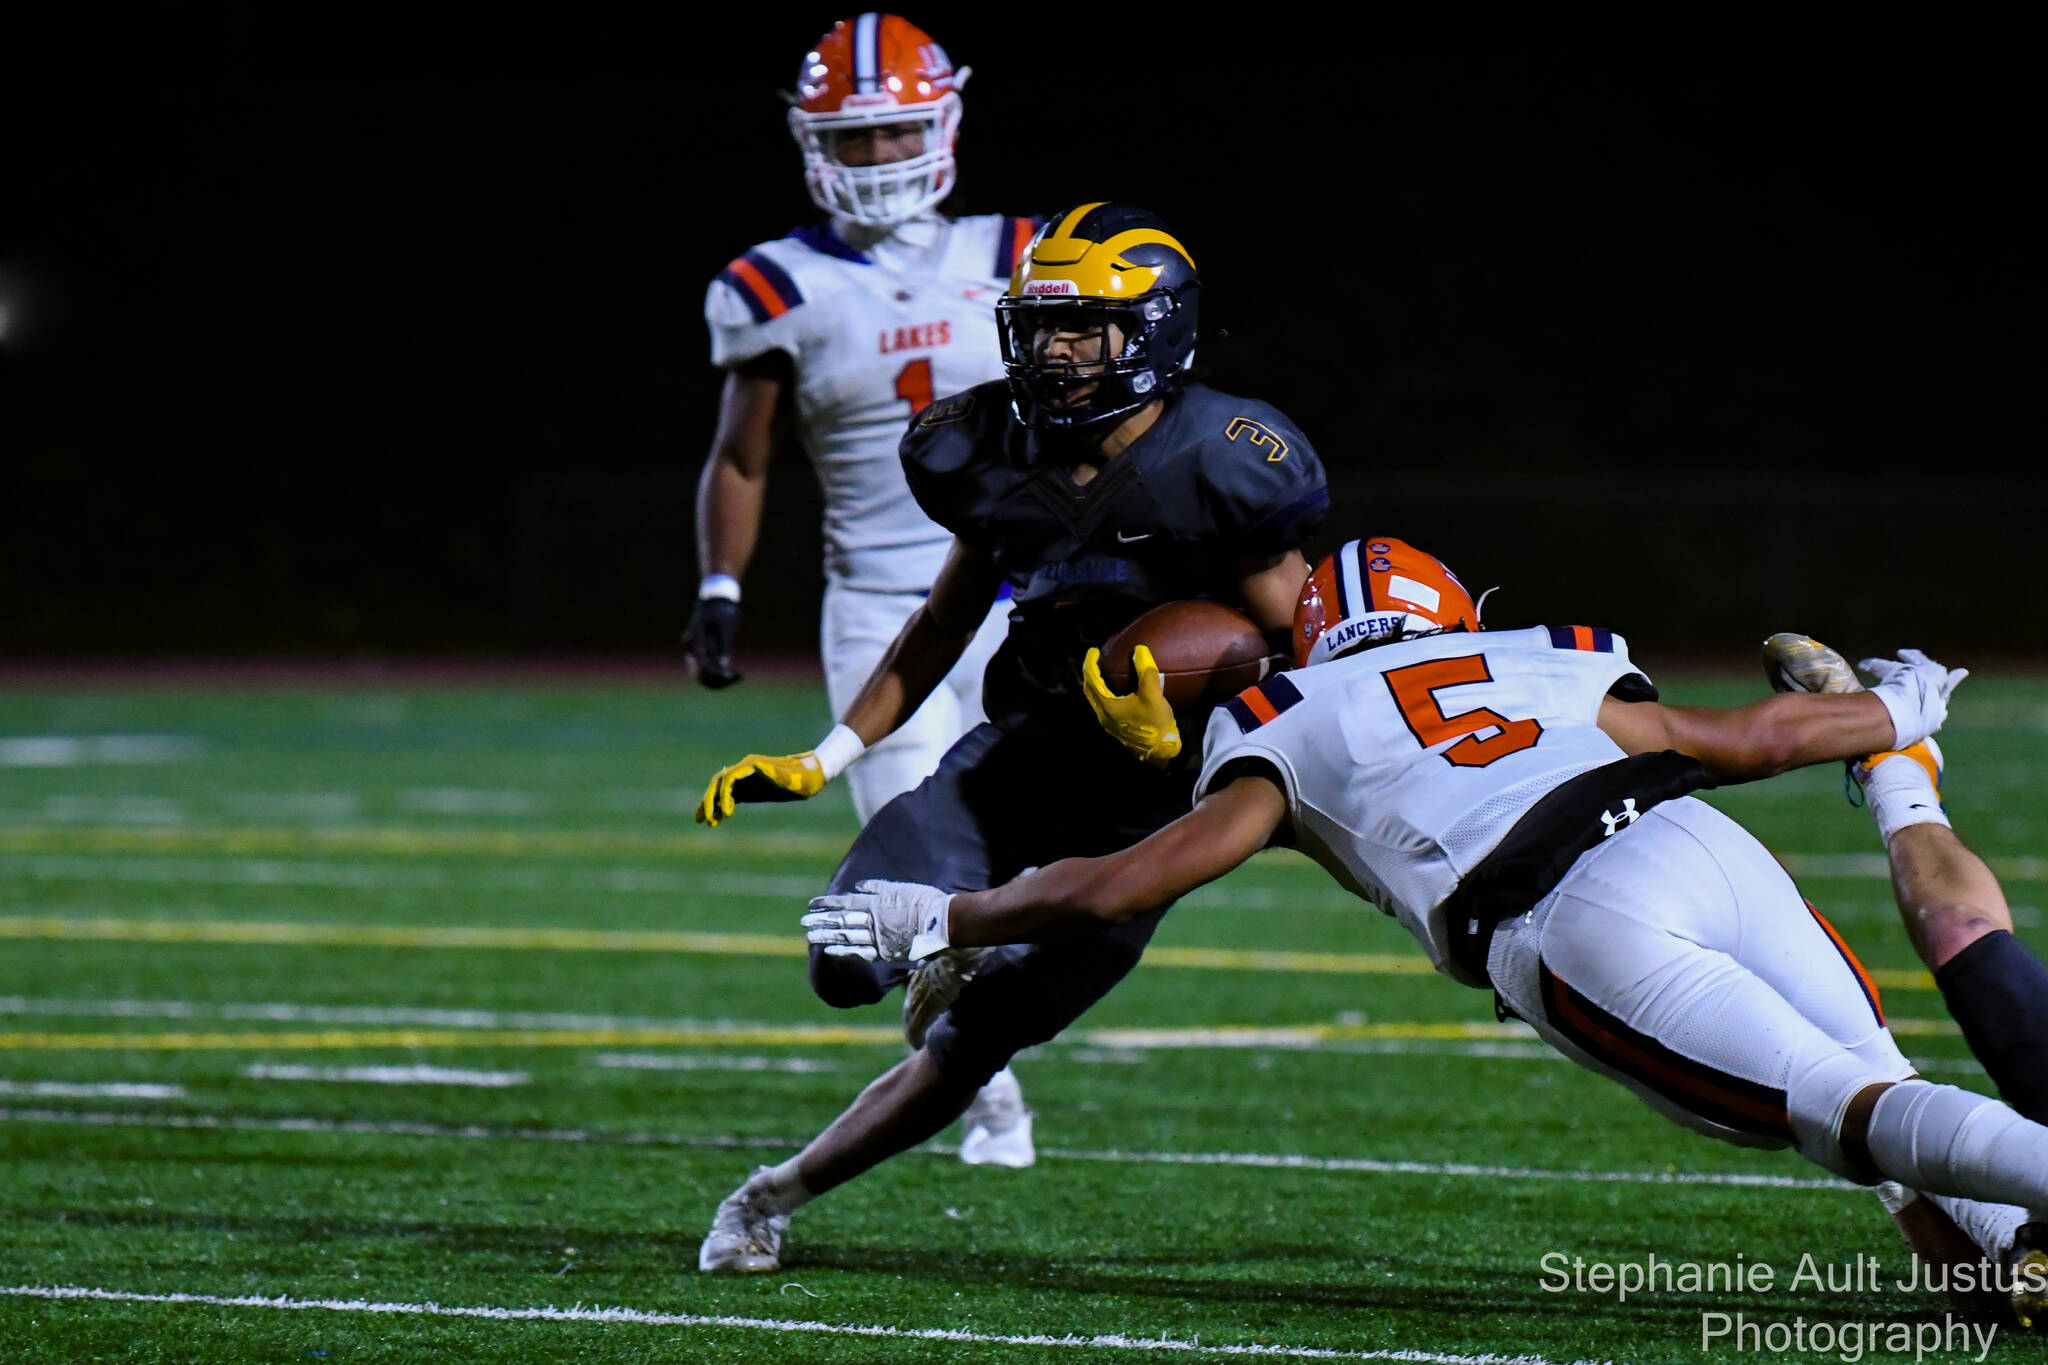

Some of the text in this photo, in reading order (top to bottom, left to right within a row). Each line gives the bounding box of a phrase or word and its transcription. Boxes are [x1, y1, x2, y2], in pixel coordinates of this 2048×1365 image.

[879, 320, 951, 355] LAKES
[894, 357, 933, 414] 1
[1225, 417, 1288, 461] 3
[1380, 653, 1544, 768] 5
